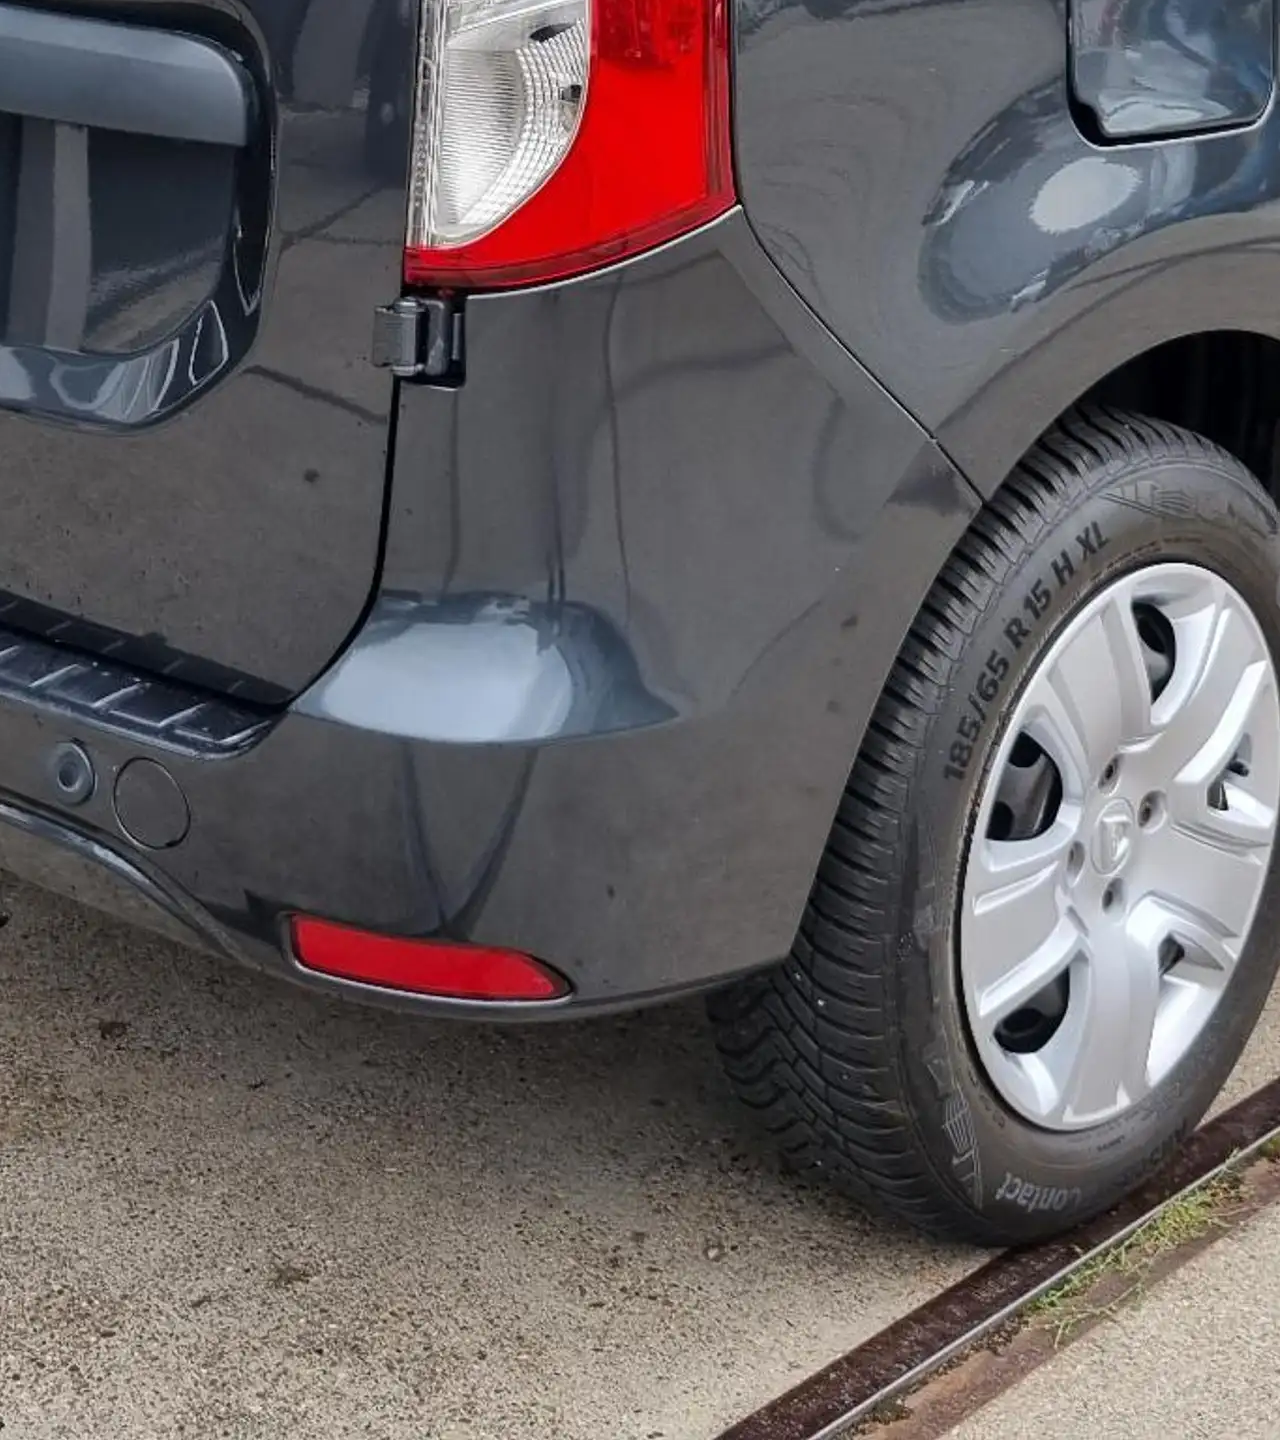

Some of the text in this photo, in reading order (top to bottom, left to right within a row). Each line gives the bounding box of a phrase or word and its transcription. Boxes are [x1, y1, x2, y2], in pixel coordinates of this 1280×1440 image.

[943, 520, 1111, 782] 185/65 R 15 H XL
